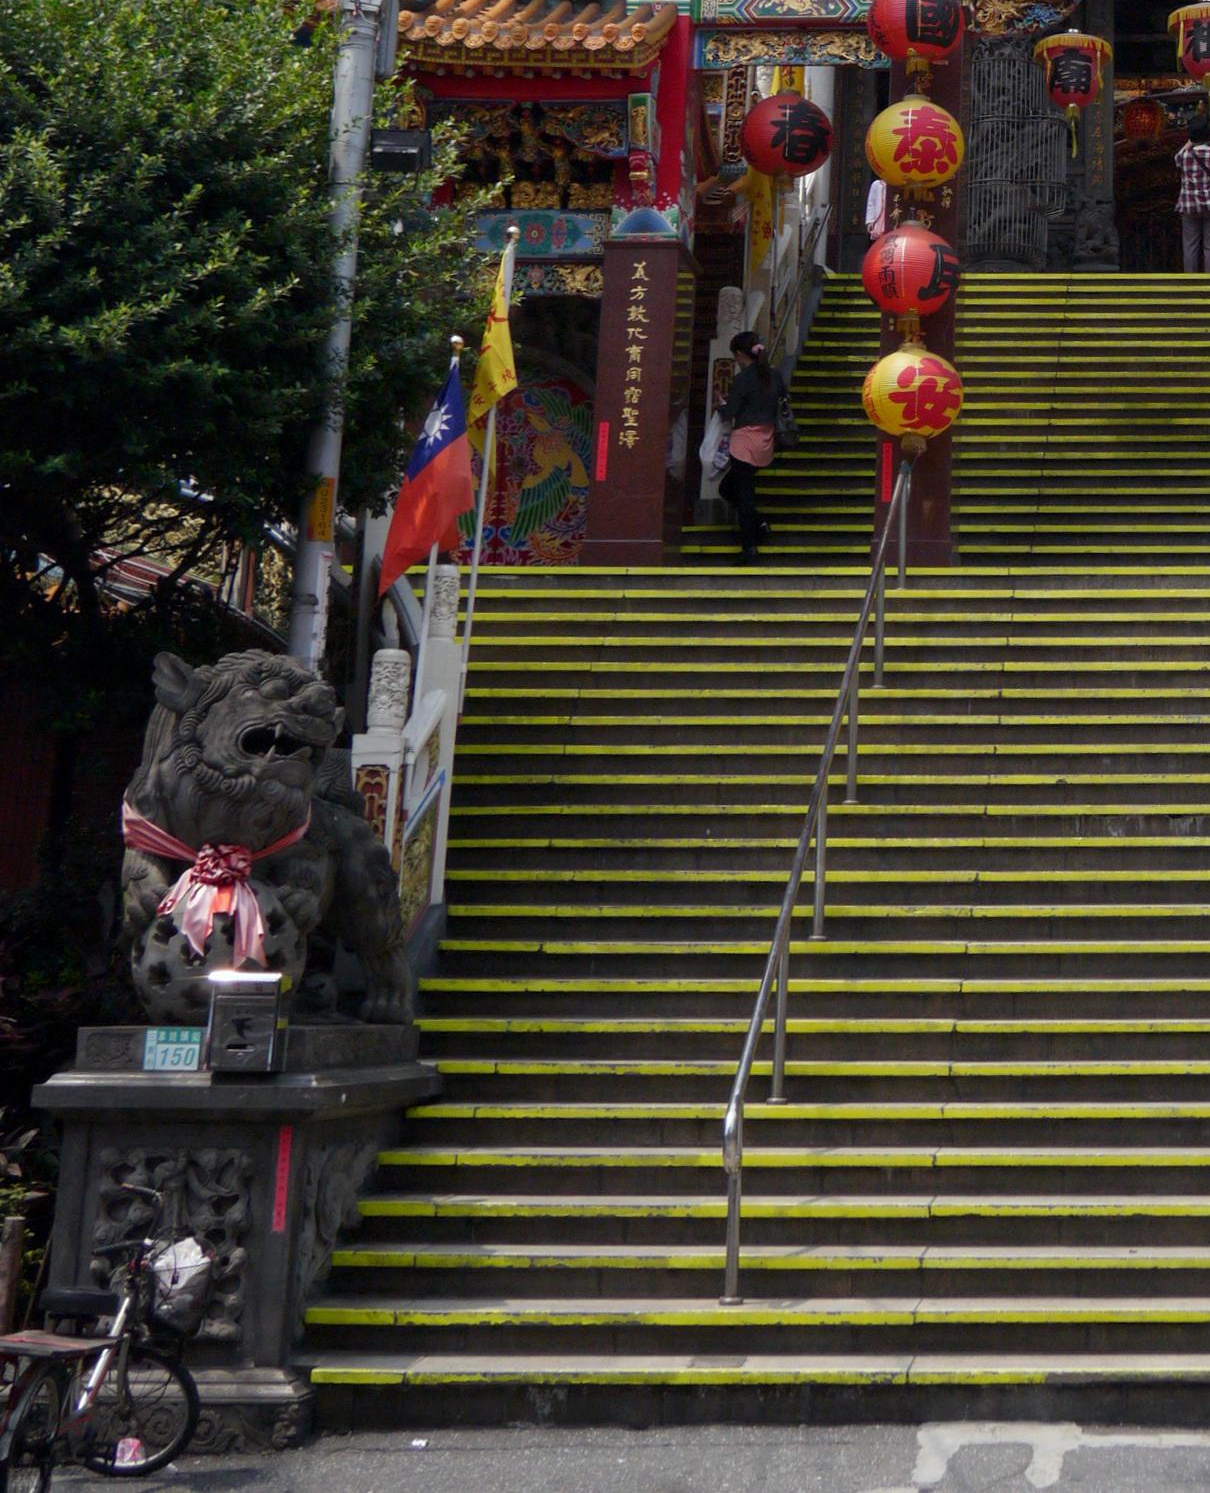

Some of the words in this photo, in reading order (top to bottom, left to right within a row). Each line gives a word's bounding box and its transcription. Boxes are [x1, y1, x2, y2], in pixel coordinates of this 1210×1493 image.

[1050, 49, 1092, 95] 廟
[770, 101, 829, 164] 春
[892, 106, 958, 174] 泰
[888, 358, 961, 430] 安
[160, 1047, 196, 1066] 150
